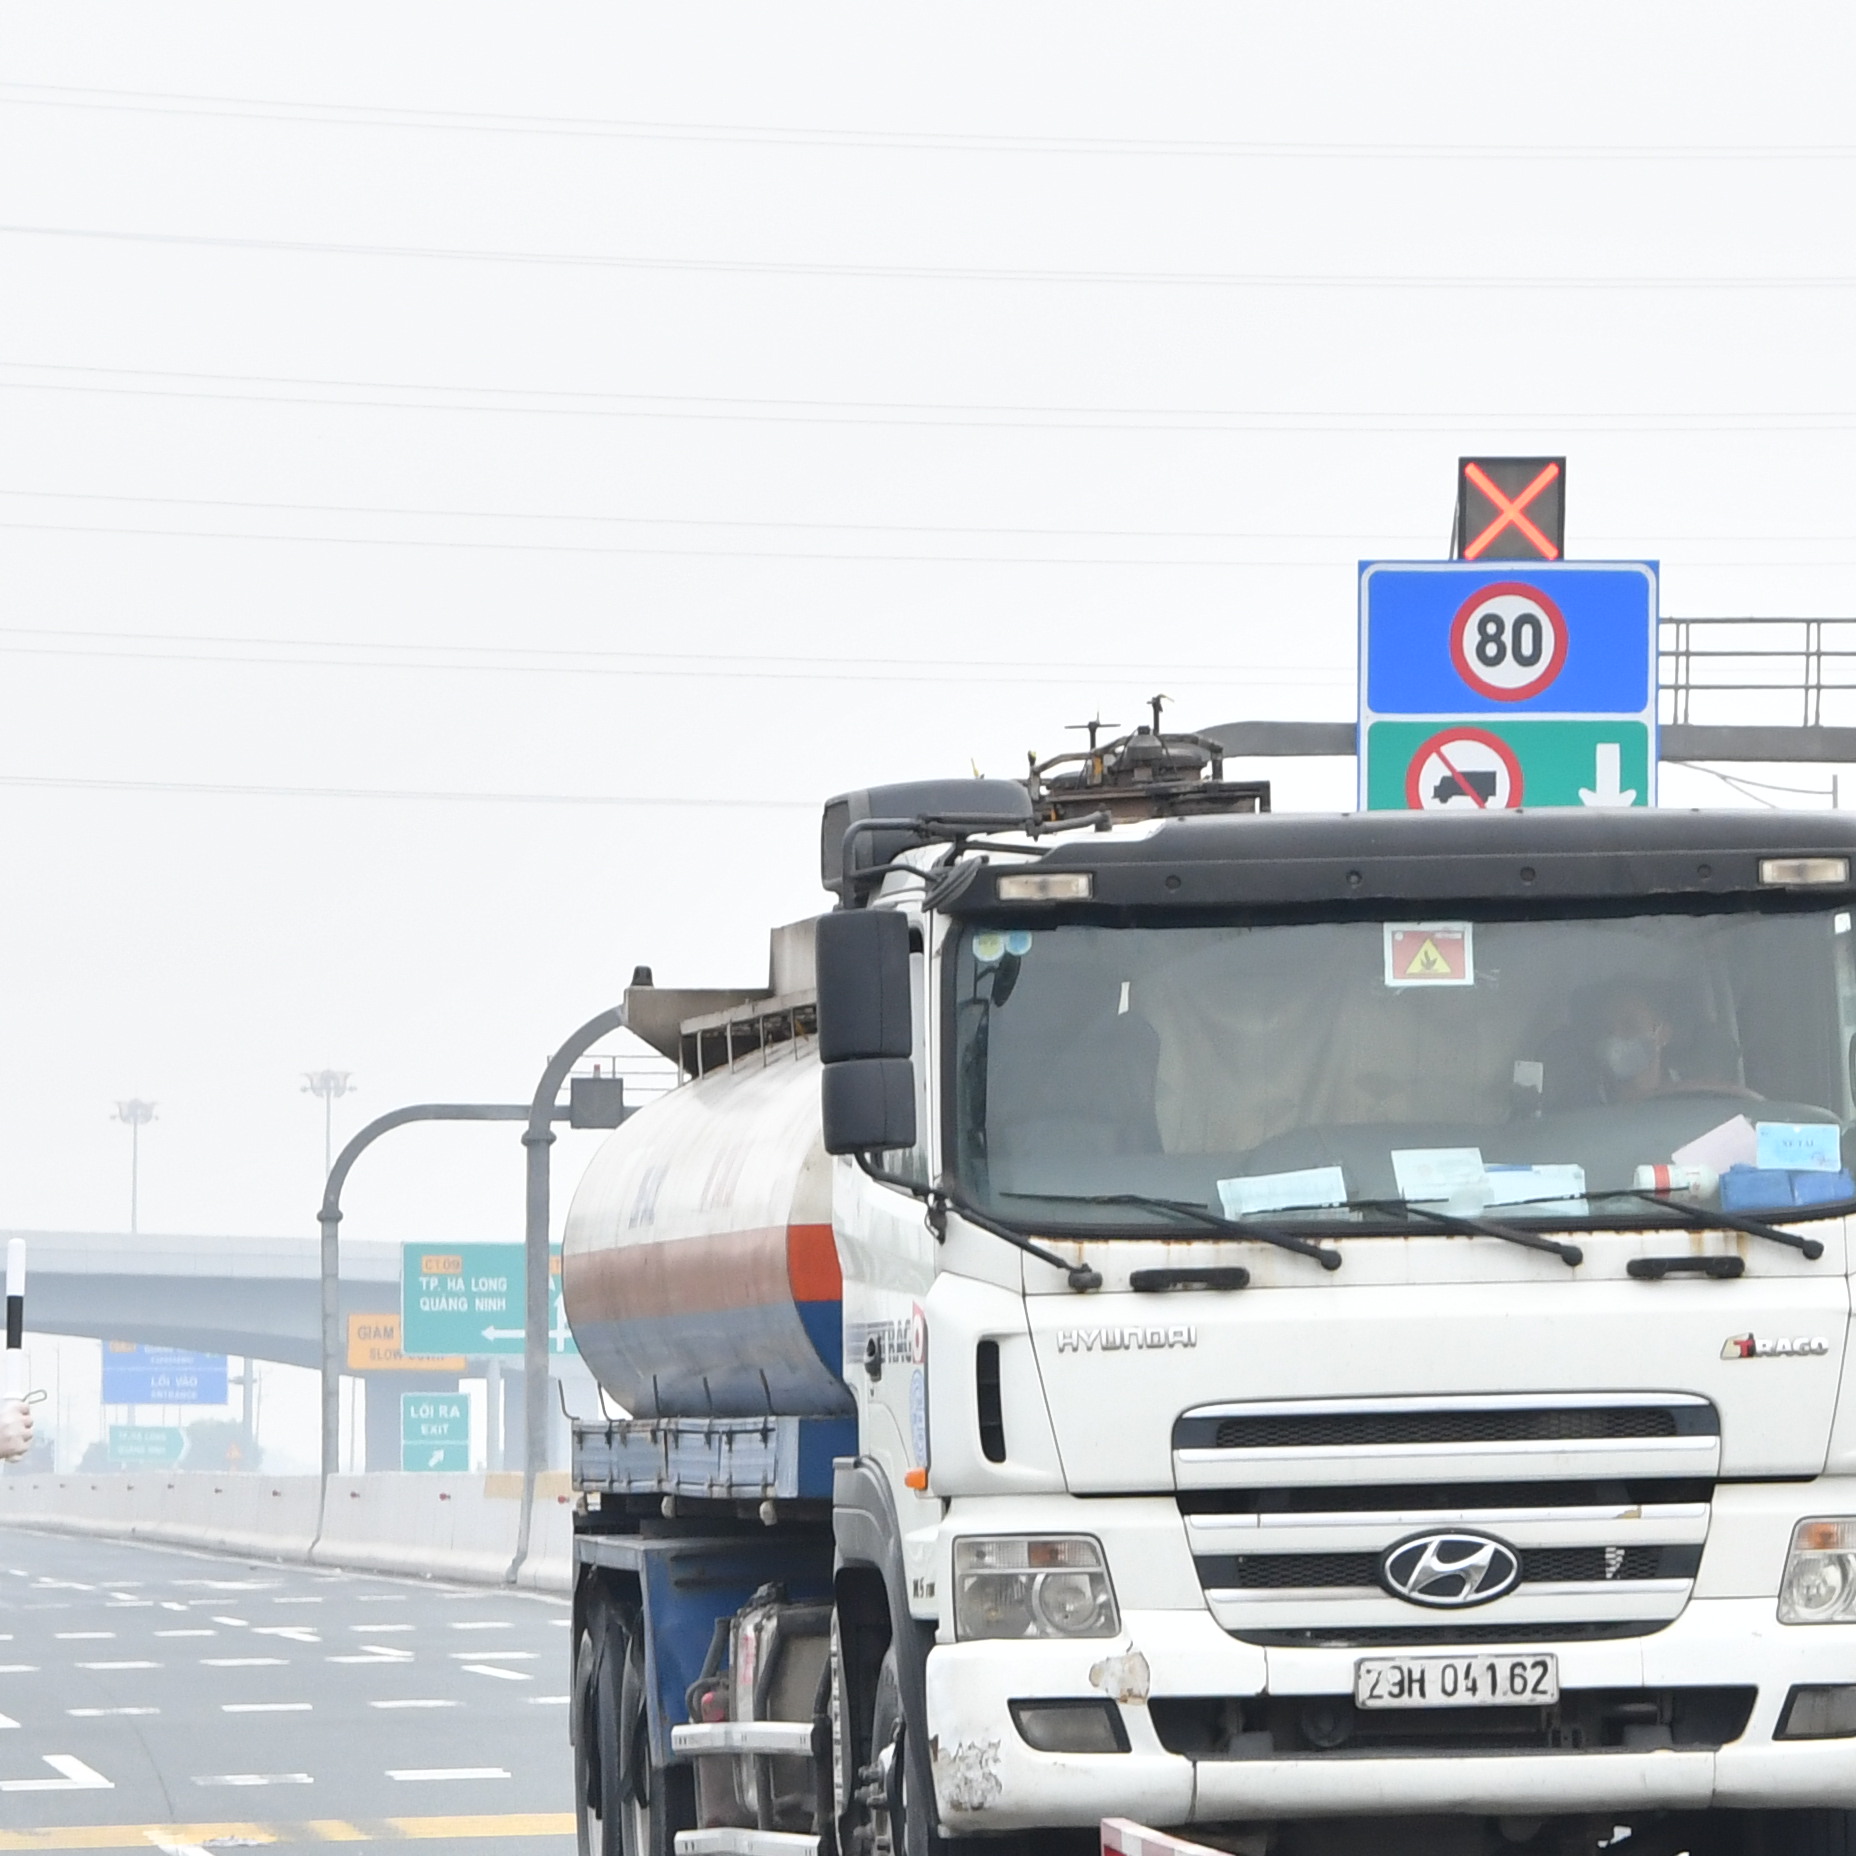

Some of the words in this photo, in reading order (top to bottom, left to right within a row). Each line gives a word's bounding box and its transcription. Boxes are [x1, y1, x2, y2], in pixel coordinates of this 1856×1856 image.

[1474, 612, 1544, 668] 80
[419, 1276, 441, 1291] TP.
[471, 1276, 507, 1292] LONG
[475, 1296, 506, 1311] NINH
[1057, 1325, 1197, 1353] HYUNDAI
[439, 1404, 461, 1418] RA
[421, 1424, 449, 1435] EXIT
